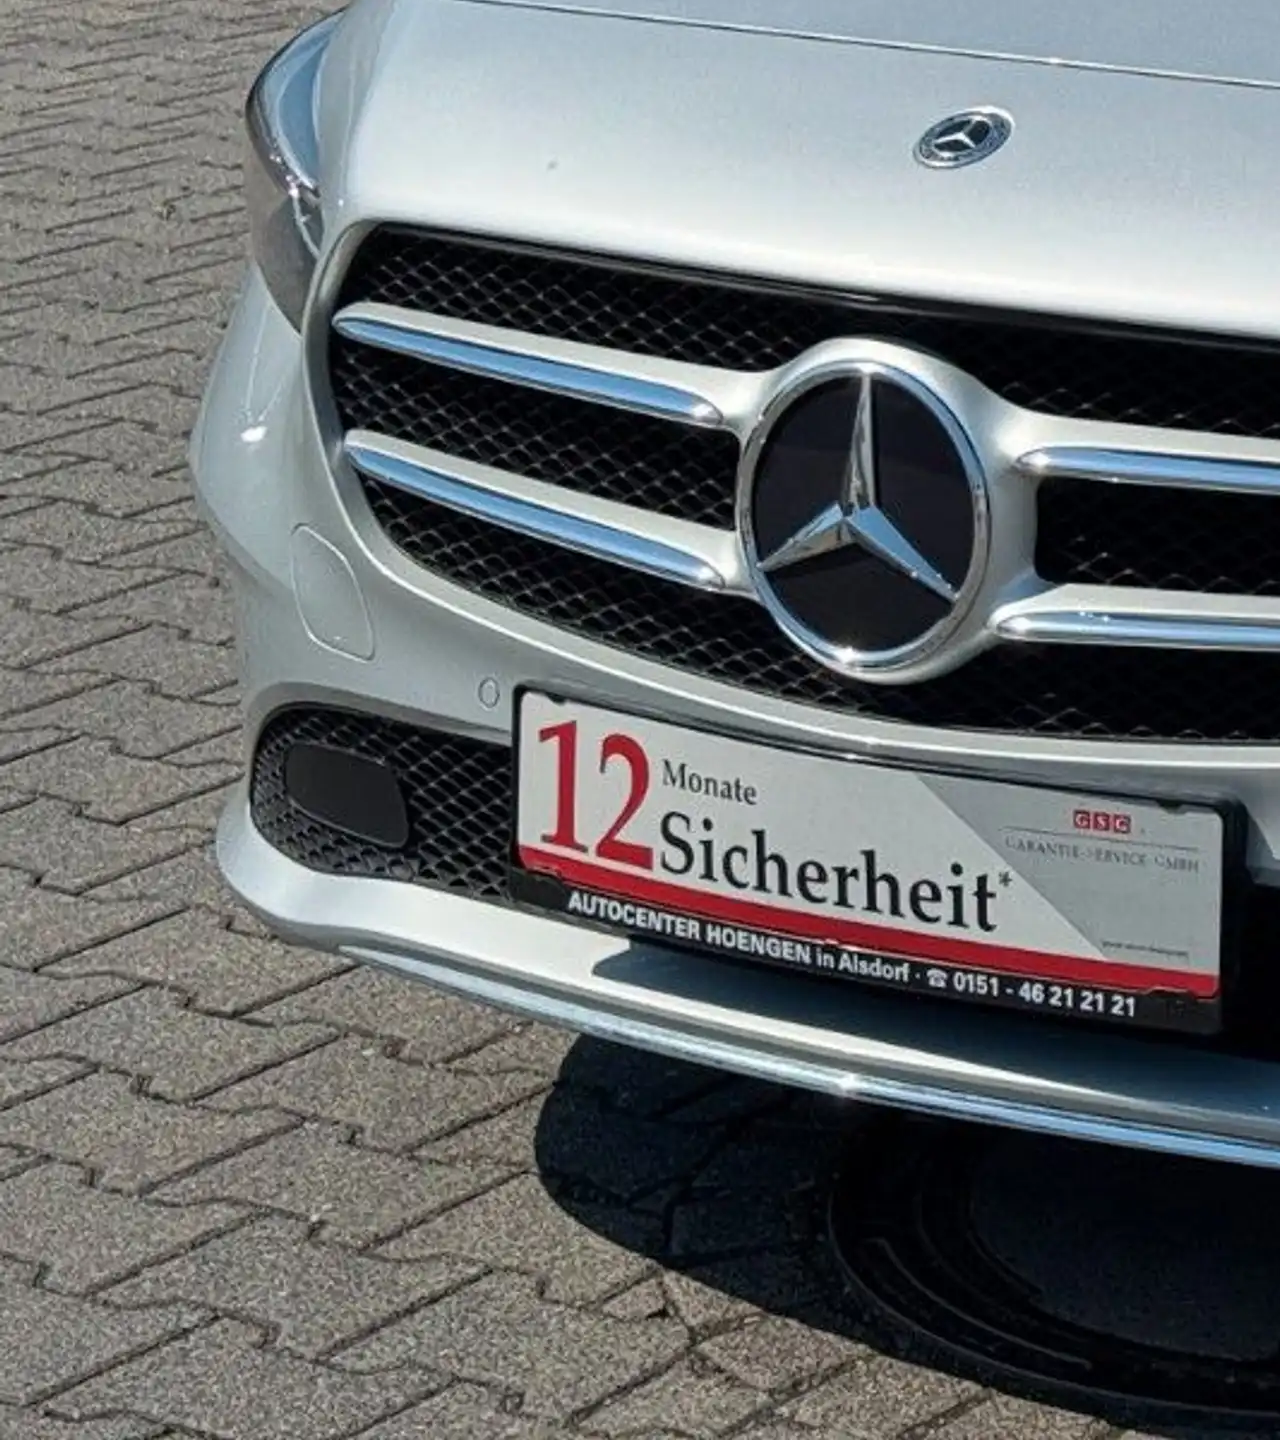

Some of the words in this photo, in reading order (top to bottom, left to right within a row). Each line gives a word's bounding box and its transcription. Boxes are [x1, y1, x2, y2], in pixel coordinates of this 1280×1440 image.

[538, 720, 653, 872] 12
[662, 759, 757, 806] Monate
[568, 890, 701, 942] AUTOCENTER
[705, 922, 812, 965] HOENGEN
[815, 947, 835, 969] in
[838, 952, 910, 982] Alsdorf
[953, 971, 999, 997] 0151
[1018, 981, 1045, 1004] 46
[1049, 985, 1074, 1008] 21
[1080, 990, 1105, 1013] 21
[1110, 996, 1136, 1017] 21
